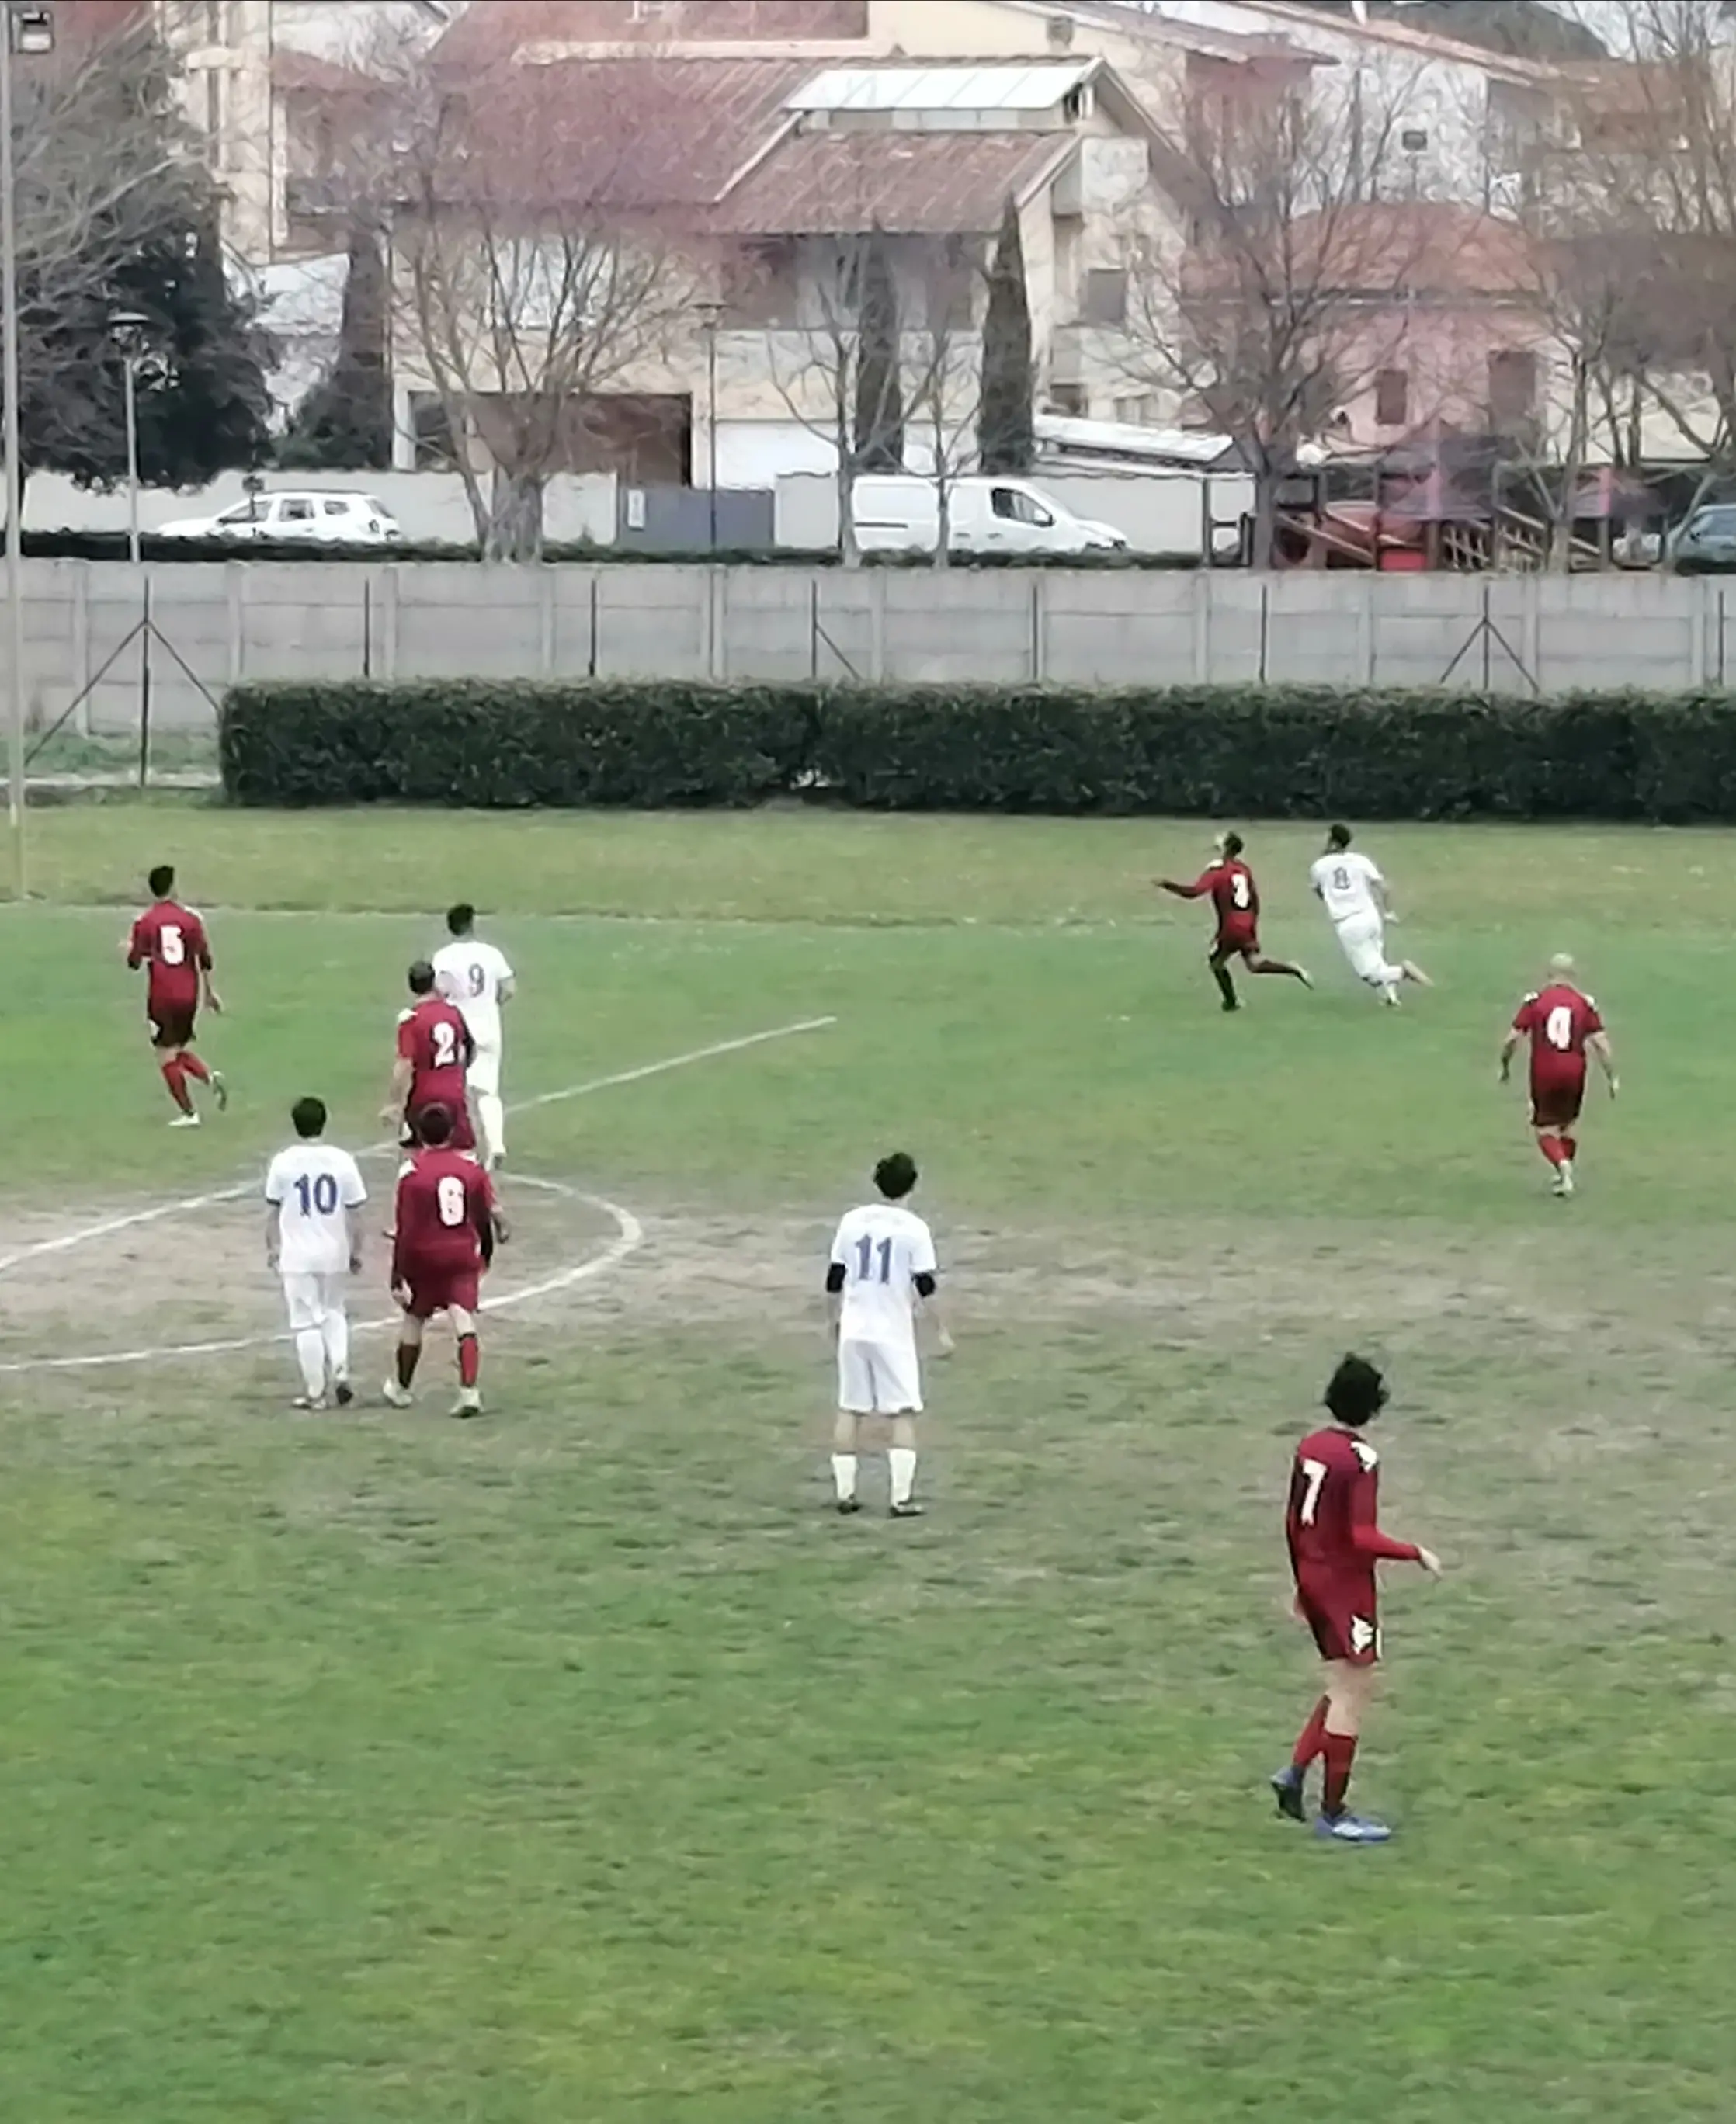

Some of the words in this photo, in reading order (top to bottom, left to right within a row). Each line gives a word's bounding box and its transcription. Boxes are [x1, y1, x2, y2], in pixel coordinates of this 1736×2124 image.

[1333, 867, 1350, 890] 8
[161, 925, 184, 965] 5
[468, 963, 485, 998] 9
[433, 1022, 456, 1067] 2
[1547, 1007, 1571, 1050] 4
[293, 1173, 338, 1216] 10
[438, 1176, 465, 1227] 6
[855, 1234, 891, 1285] 11
[1301, 1459, 1327, 1525] 7
